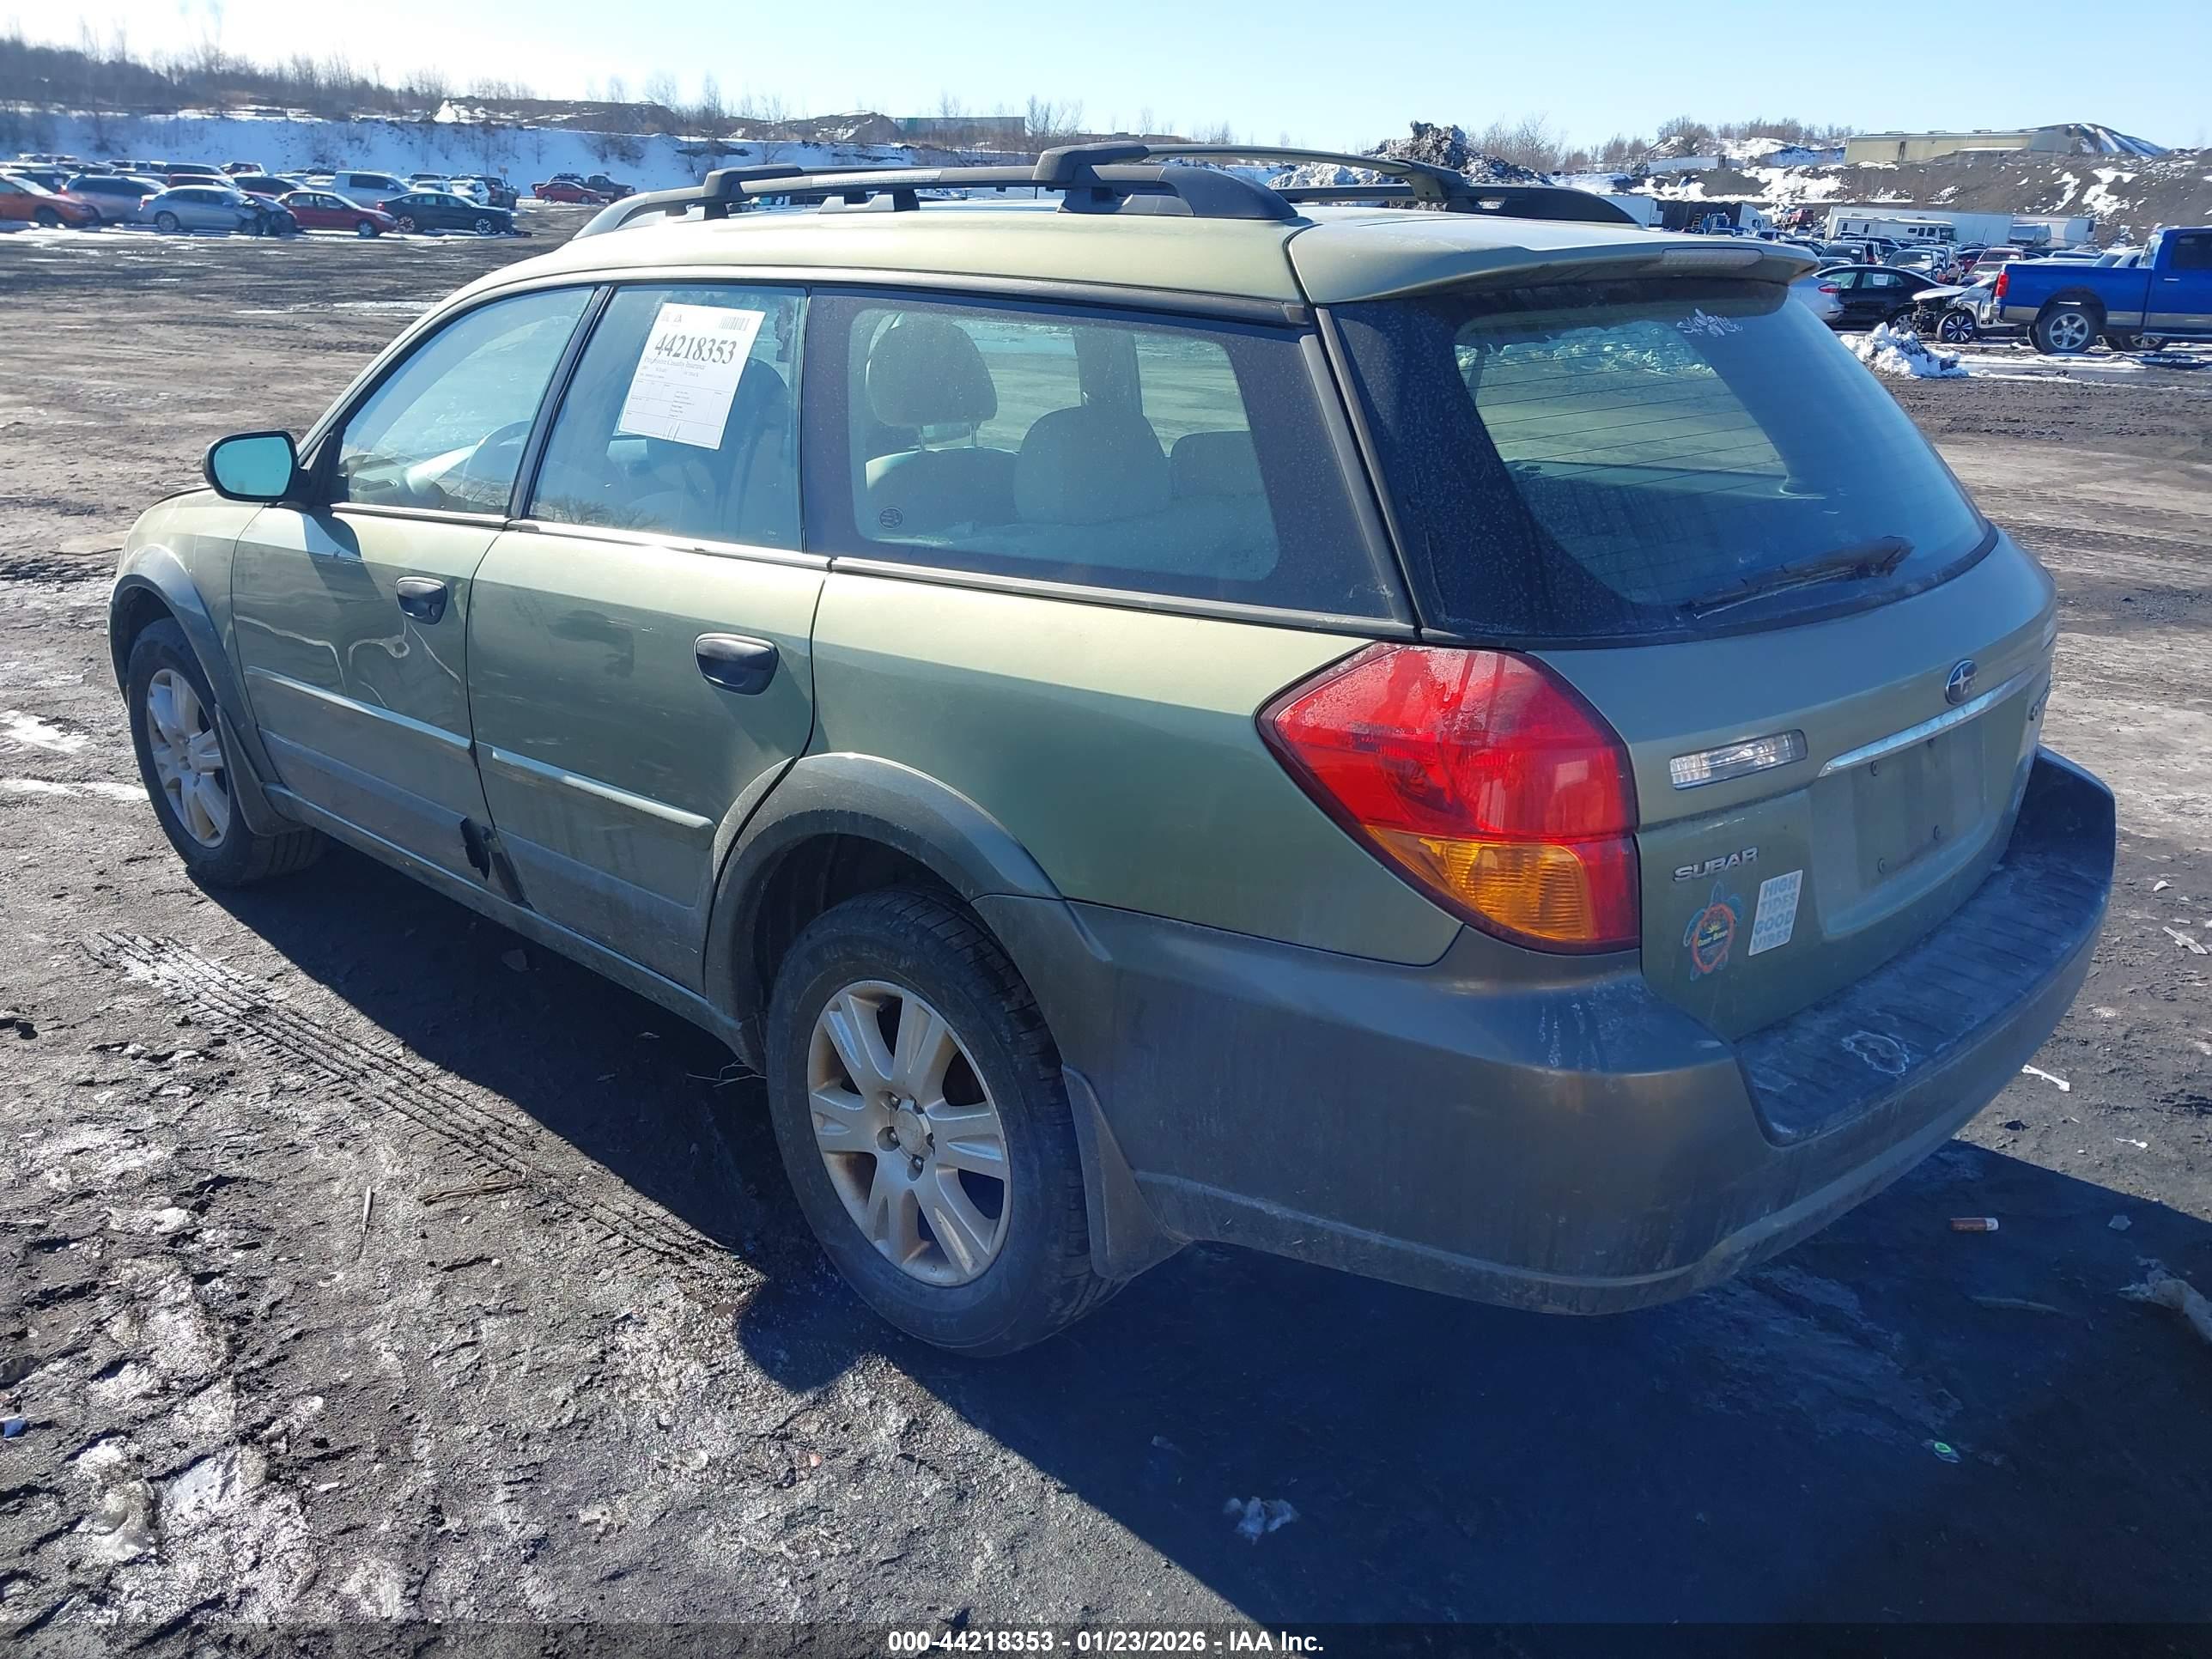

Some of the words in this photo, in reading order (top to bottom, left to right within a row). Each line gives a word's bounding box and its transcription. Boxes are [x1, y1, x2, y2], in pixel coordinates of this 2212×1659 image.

[654, 332, 738, 365] 44218353
[1673, 847, 1759, 882] SUBAR
[1763, 873, 1799, 899] HIGH
[1759, 891, 1798, 915] TIDES
[1754, 909, 1795, 935] GOOD
[1753, 927, 1791, 951] VIBES
